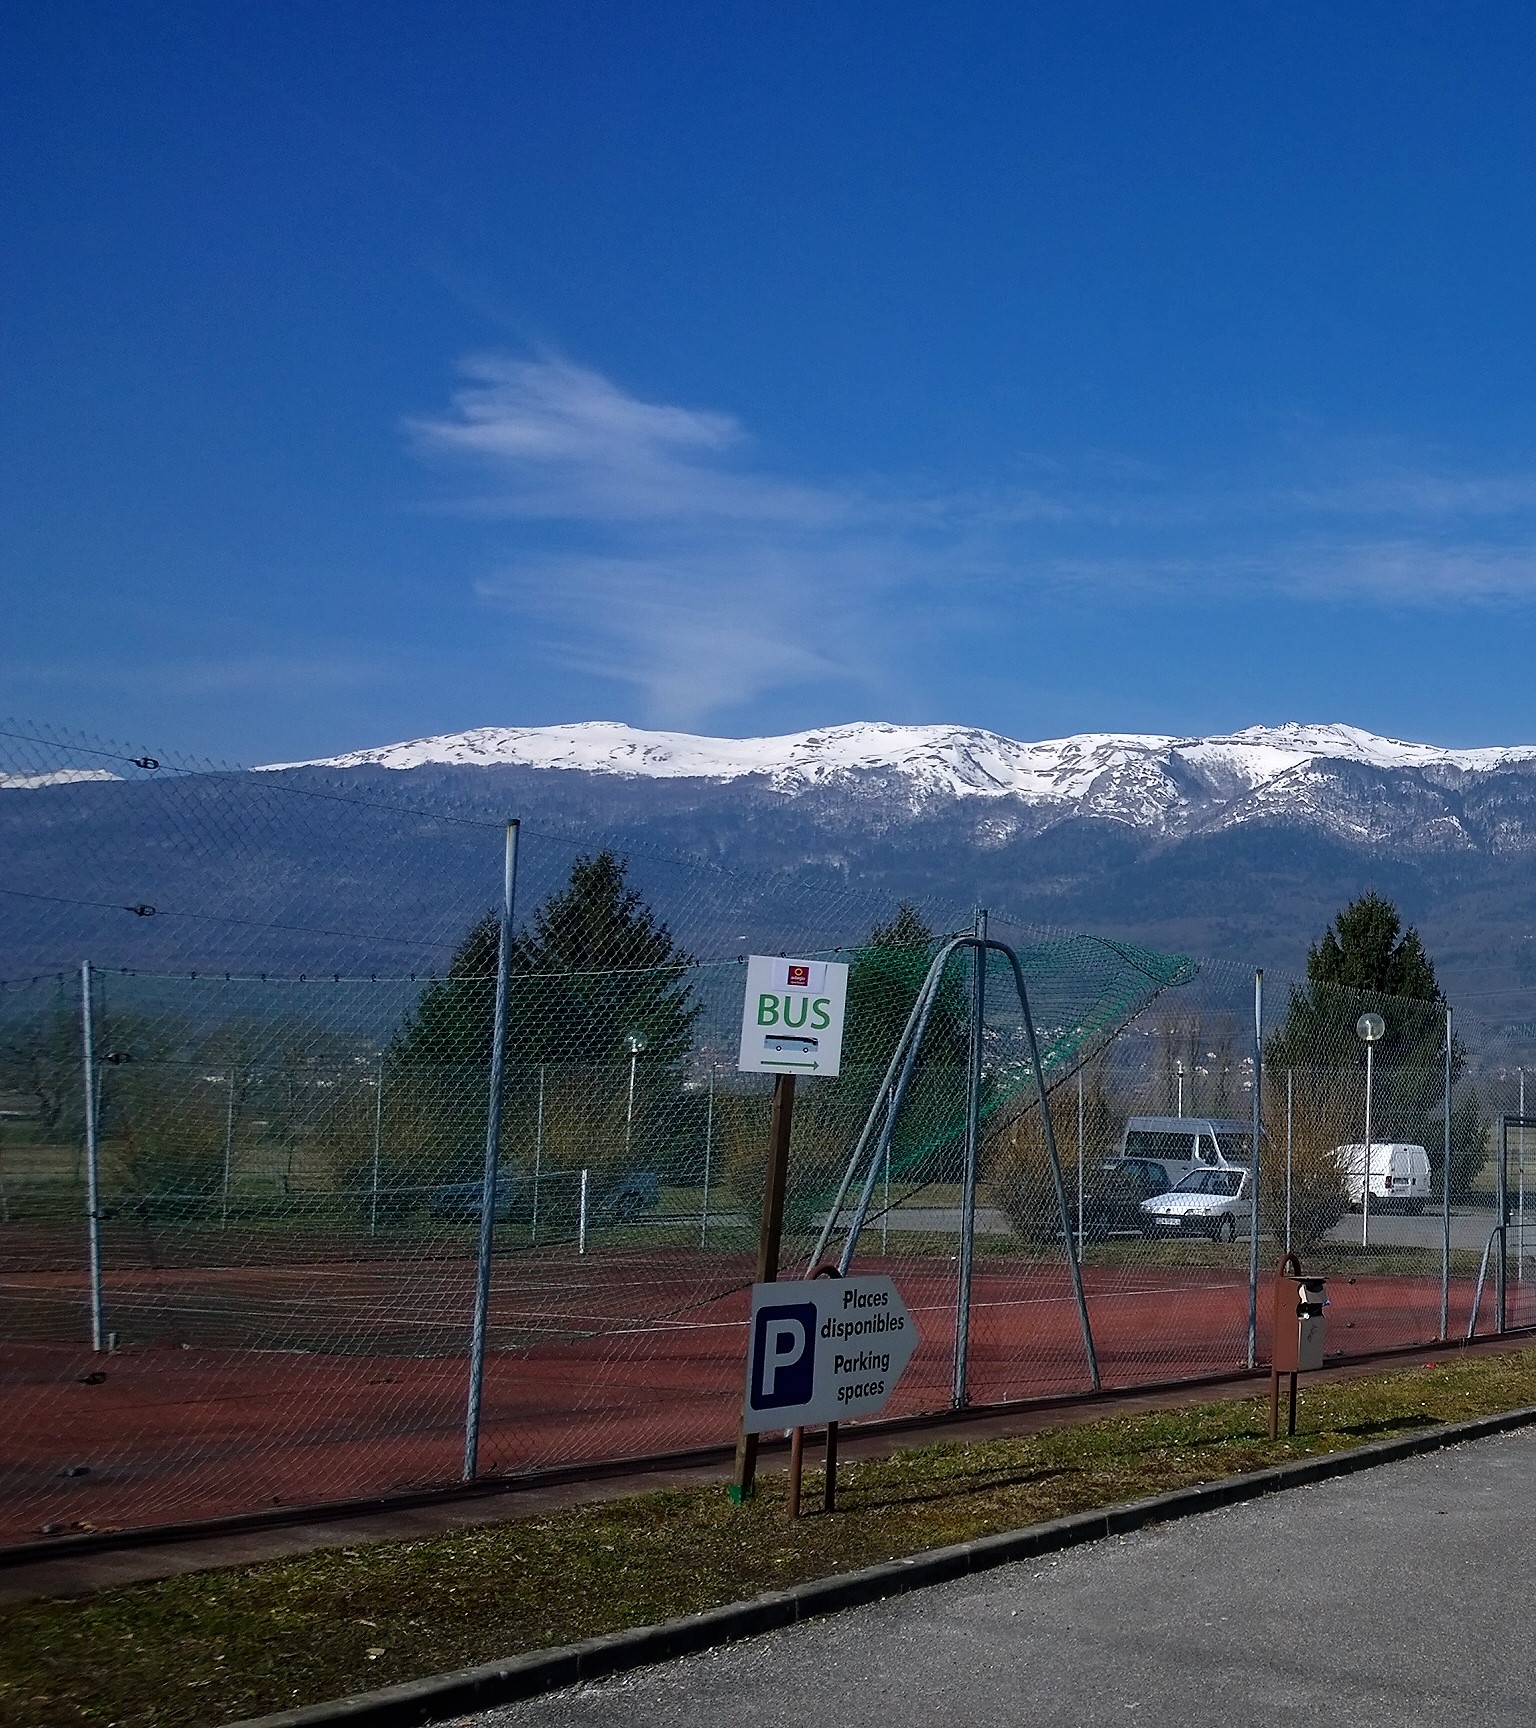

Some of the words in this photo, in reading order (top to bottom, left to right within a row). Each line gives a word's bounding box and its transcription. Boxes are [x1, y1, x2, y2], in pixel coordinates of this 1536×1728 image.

[757, 994, 831, 1030] BUS
[843, 1288, 889, 1310] Places
[820, 1312, 905, 1342] disponibles
[761, 1318, 806, 1396] P
[834, 1350, 890, 1375] Parking
[837, 1380, 885, 1406] spaces
